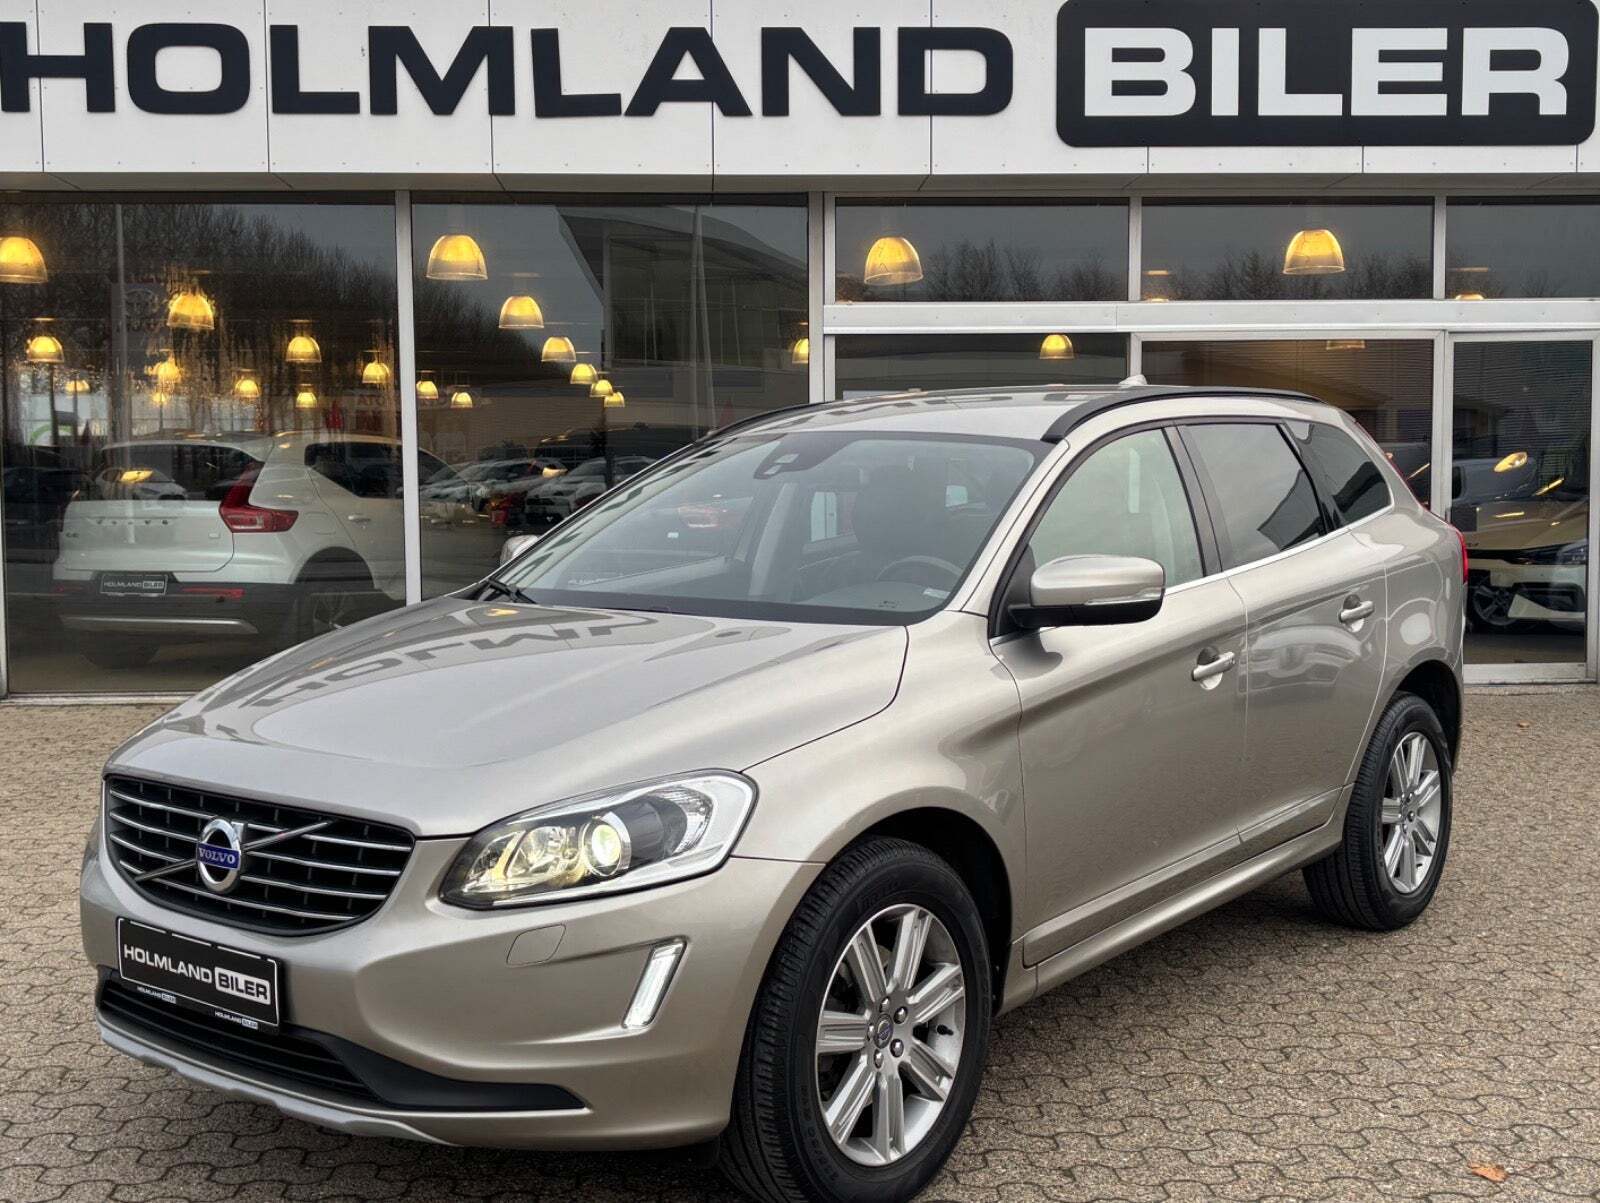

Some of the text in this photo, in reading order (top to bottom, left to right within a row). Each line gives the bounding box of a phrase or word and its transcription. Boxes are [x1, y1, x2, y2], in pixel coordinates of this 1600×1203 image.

[0, 22, 1569, 118] HOLMLAND BILER
[198, 847, 236, 865] VOLVO
[124, 943, 268, 1000] HOLMLAND BILER
